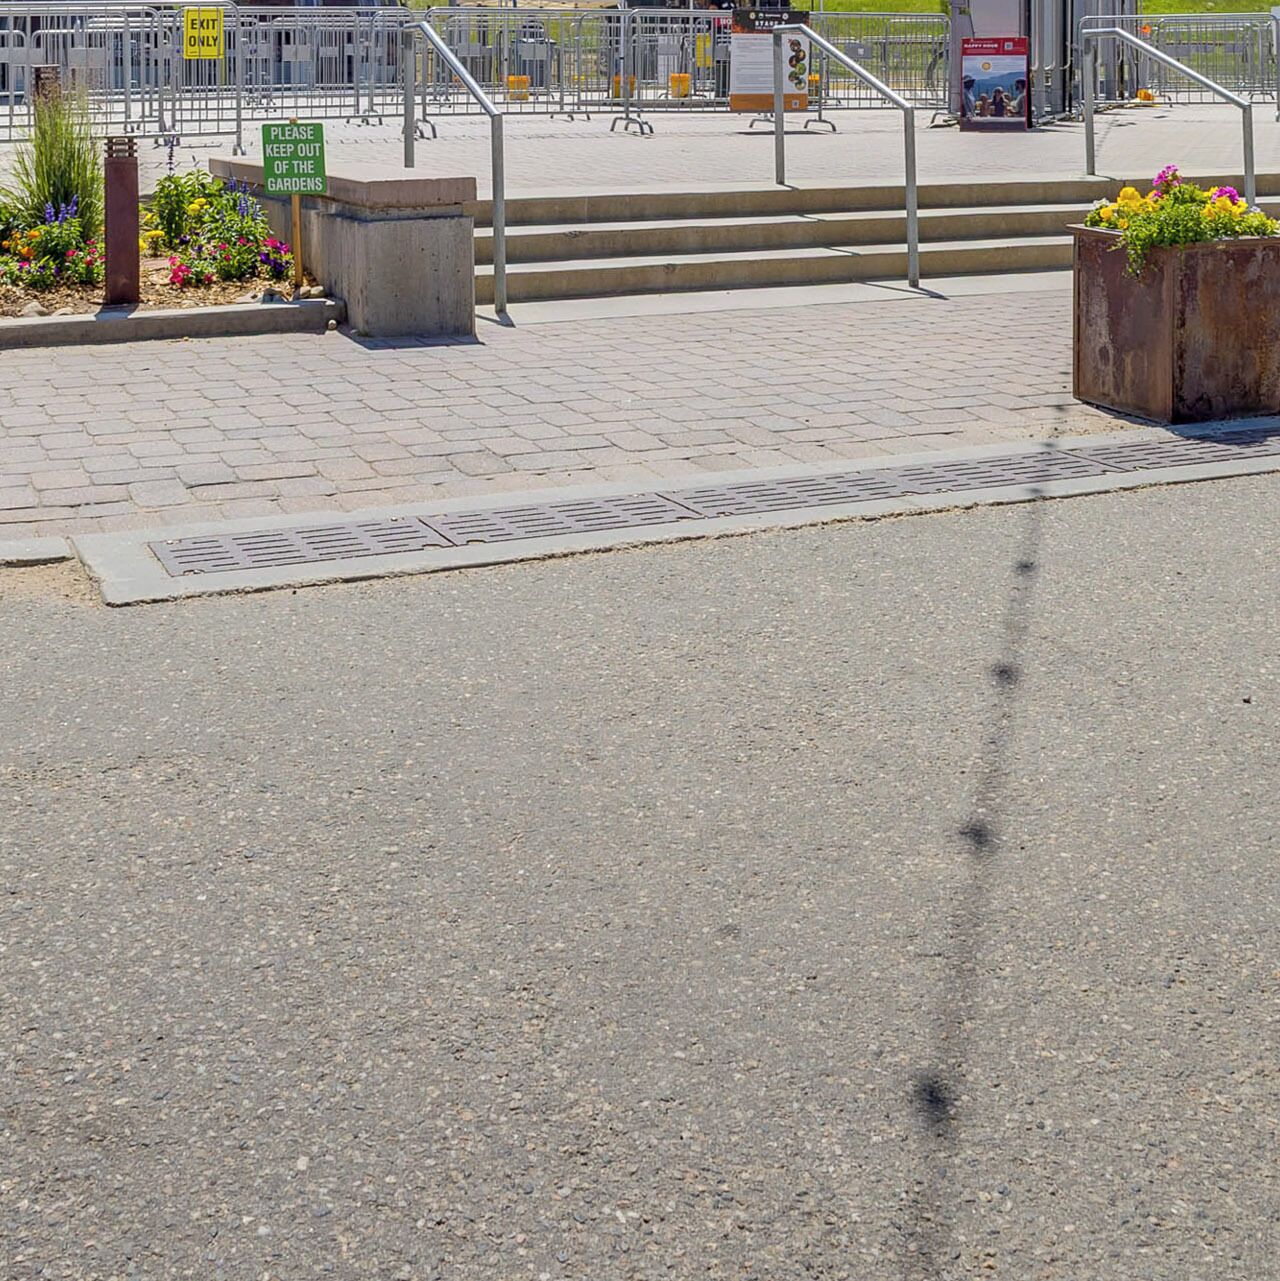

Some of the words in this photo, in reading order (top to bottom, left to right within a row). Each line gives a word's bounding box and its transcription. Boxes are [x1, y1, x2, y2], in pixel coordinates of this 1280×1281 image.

[191, 19, 218, 30] EXIT
[189, 36, 218, 47] ONLY
[271, 126, 314, 140] PLEASE
[265, 143, 294, 157] KEEP
[297, 143, 320, 157] OUT
[274, 160, 289, 174] OF
[292, 160, 315, 174] THE
[267, 177, 323, 191] GARDENS
